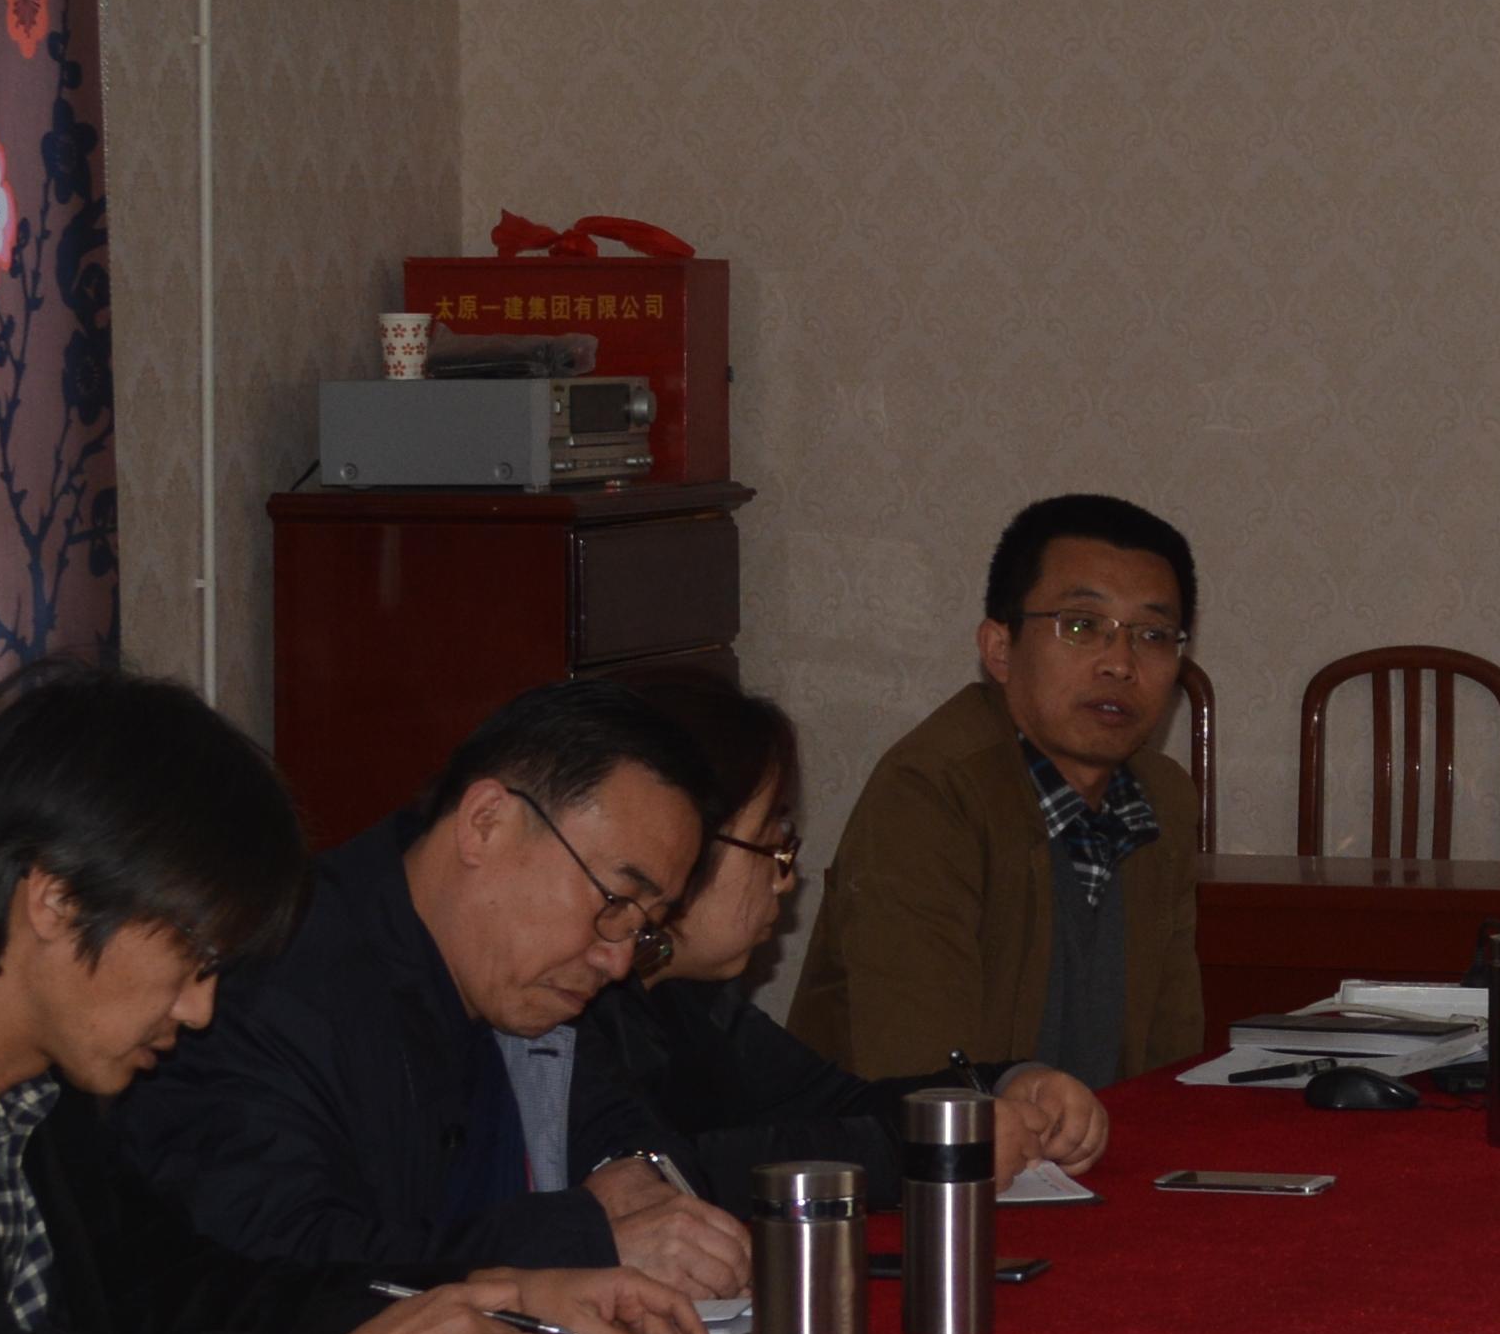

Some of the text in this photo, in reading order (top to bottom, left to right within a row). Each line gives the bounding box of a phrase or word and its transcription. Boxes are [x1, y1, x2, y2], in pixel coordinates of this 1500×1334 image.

[436, 294, 664, 320] 太原一建集团有限公司
